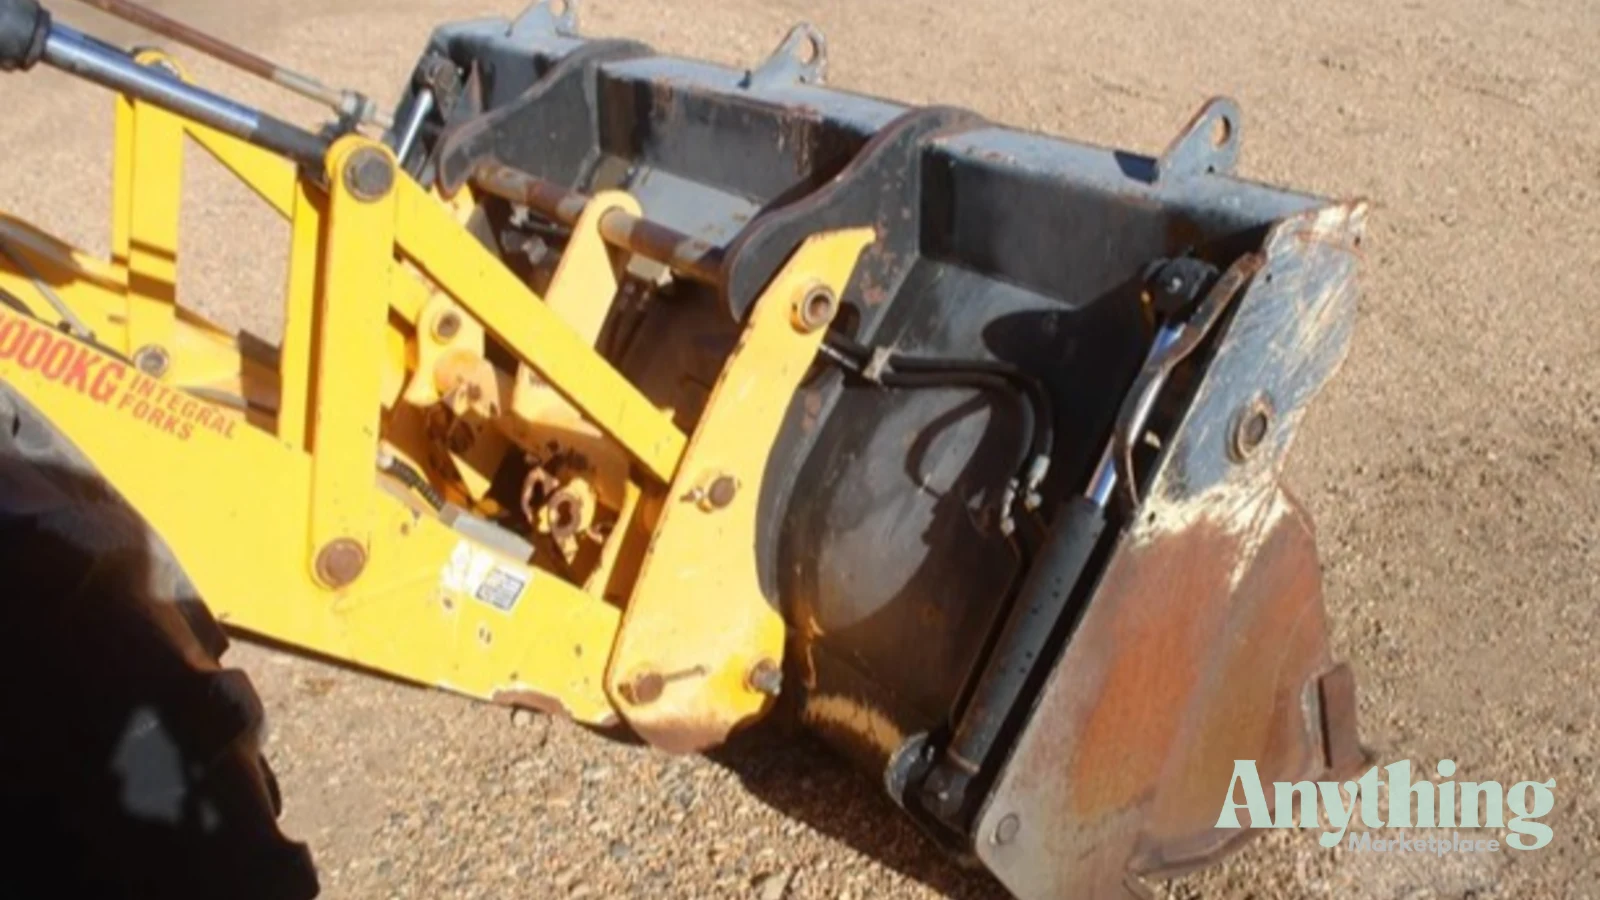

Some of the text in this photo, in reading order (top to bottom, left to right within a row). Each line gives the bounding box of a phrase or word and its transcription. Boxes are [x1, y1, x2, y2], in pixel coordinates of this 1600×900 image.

[0, 313, 126, 404] 000KG
[116, 393, 194, 441] FORKS
[129, 374, 236, 439] INTEGRAL
